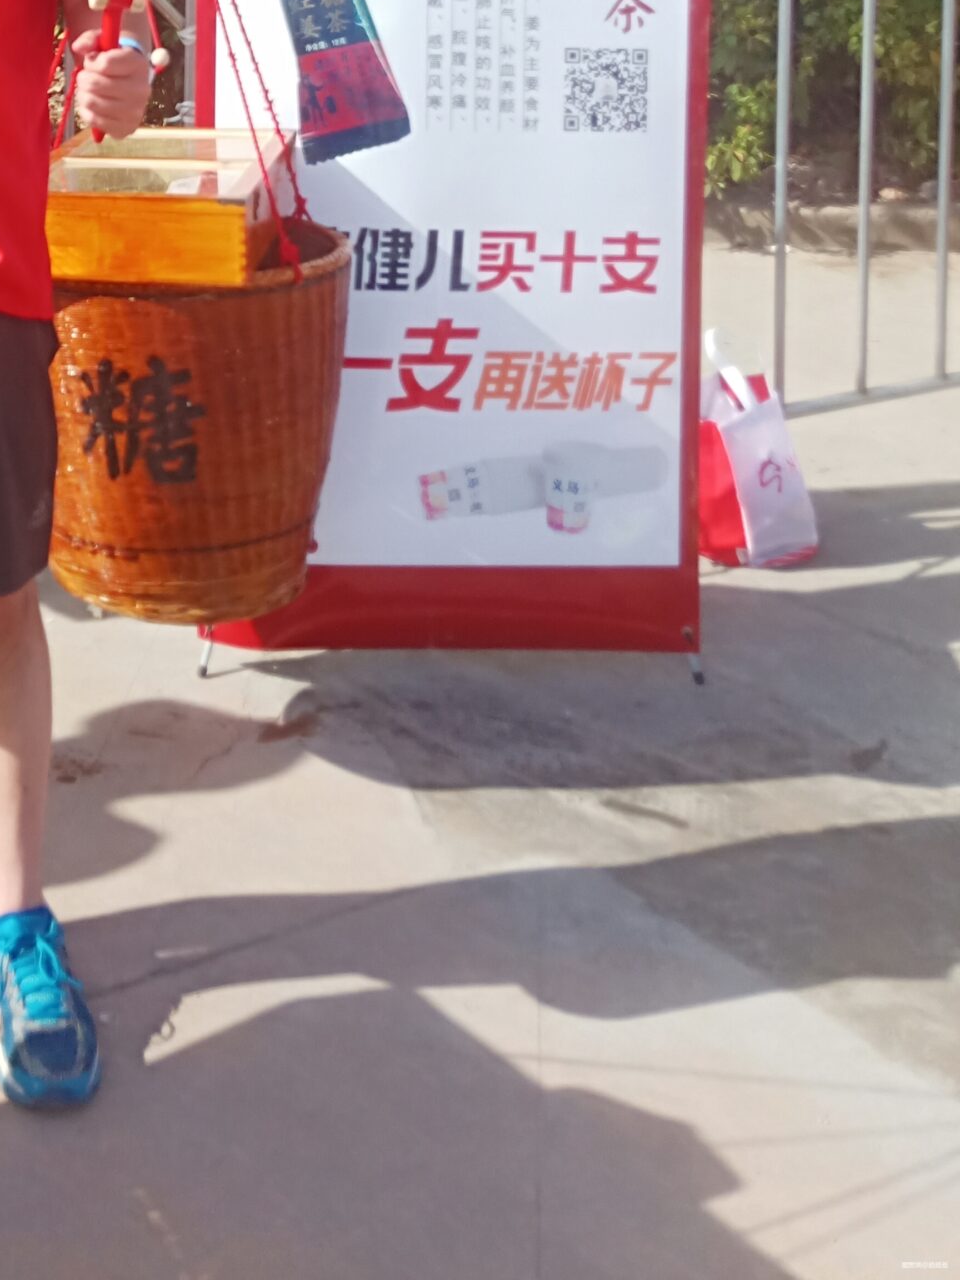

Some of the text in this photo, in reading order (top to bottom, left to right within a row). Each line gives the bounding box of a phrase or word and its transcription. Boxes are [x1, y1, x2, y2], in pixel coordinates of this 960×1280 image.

[324, 226, 661, 294] 健儿买十支
[81, 354, 205, 485] 糖
